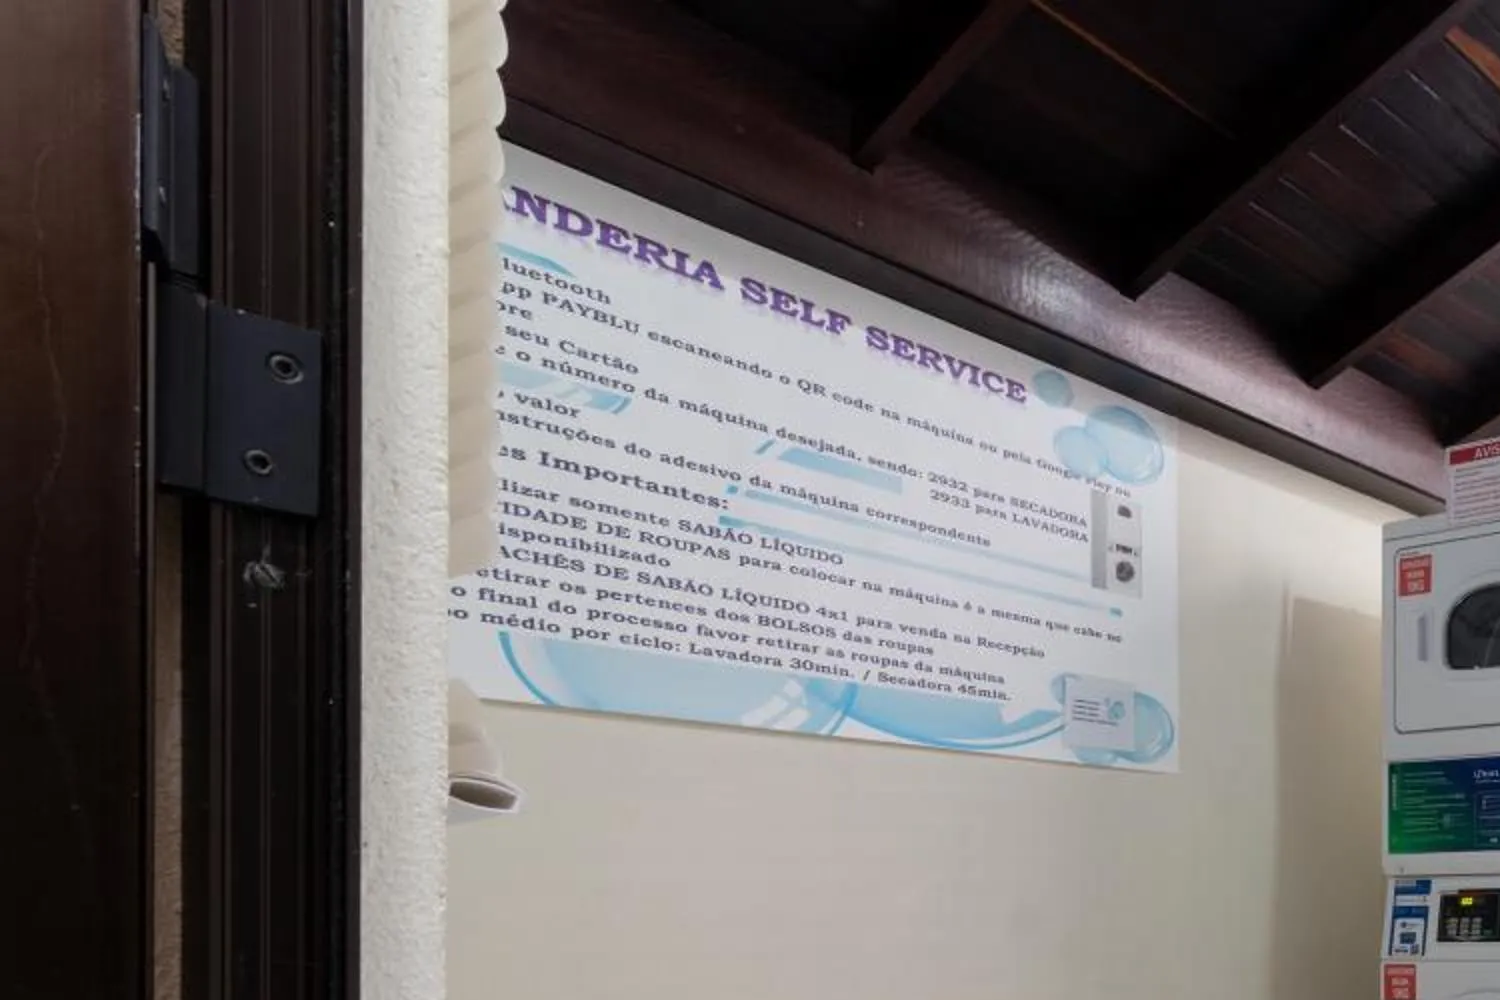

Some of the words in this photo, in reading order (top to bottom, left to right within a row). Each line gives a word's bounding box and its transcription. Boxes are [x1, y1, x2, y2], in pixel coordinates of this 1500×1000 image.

[501, 184, 725, 291] NDERIA
[739, 276, 853, 335] SELF
[865, 325, 1027, 404] SERVICE
[502, 257, 612, 305] luetooth
[504, 324, 550, 347] seu
[558, 339, 640, 375] Cartão
[542, 291, 641, 335] PAYBLU
[647, 330, 773, 379] escaneando
[779, 374, 791, 386] o
[797, 378, 827, 397] QR
[832, 391, 875, 413] code
[880, 407, 901, 422] na
[513, 391, 581, 419] valor
[515, 351, 532, 362] o
[541, 356, 636, 394] número
[644, 387, 670, 404] da
[678, 398, 768, 434] máquina
[867, 453, 925, 479] sendo:
[927, 470, 969, 493] 2932
[973, 485, 1006, 505] para
[1009, 495, 1088, 528] SECADORA
[538, 450, 729, 510] Importantes:
[623, 442, 652, 460] do
[659, 452, 742, 483] adesivo
[749, 474, 773, 491] da
[780, 482, 860, 514] máquina
[865, 506, 991, 548] correspondente
[929, 488, 971, 510] 2933
[975, 501, 1008, 521] para
[1011, 512, 1090, 543] LAVADORA
[497, 501, 587, 530] IDADE
[597, 521, 631, 540] DE
[639, 532, 731, 561] ROUPAS
[738, 554, 782, 573] para
[789, 564, 856, 588] colocar
[862, 579, 883, 594] na
[889, 585, 959, 609] máquina
[991, 608, 1042, 626] mesma
[498, 522, 671, 568] isponibilizado
[569, 496, 671, 527] somente
[760, 535, 844, 566] LÍQUIDO
[478, 587, 538, 609] final
[548, 599, 577, 615] do
[587, 608, 687, 633] processo
[697, 623, 750, 643] favor
[757, 634, 821, 655] retirar
[826, 646, 846, 658] as
[851, 650, 909, 670] roupas
[914, 660, 933, 673] da
[939, 665, 1005, 684] máquina
[559, 581, 587, 595] os
[596, 587, 707, 617] pertences
[715, 607, 750, 624] dos
[757, 614, 837, 639] BOLSOS
[843, 631, 873, 645] das
[878, 637, 935, 656] roupas
[594, 562, 630, 581] DE
[636, 571, 714, 597] SABÃO
[722, 587, 811, 617] LÍQUIDO
[856, 615, 892, 632] para
[899, 622, 947, 640] venda
[953, 634, 971, 645] na
[976, 636, 1045, 658] Recepção
[448, 607, 469, 620] o
[480, 613, 561, 634] médio
[571, 626, 611, 641] por
[619, 633, 681, 652] ciclo:
[689, 642, 783, 668] Lavadora
[789, 657, 855, 679] 30min.
[878, 670, 952, 693] Secadora
[957, 685, 1012, 702] 45min.
